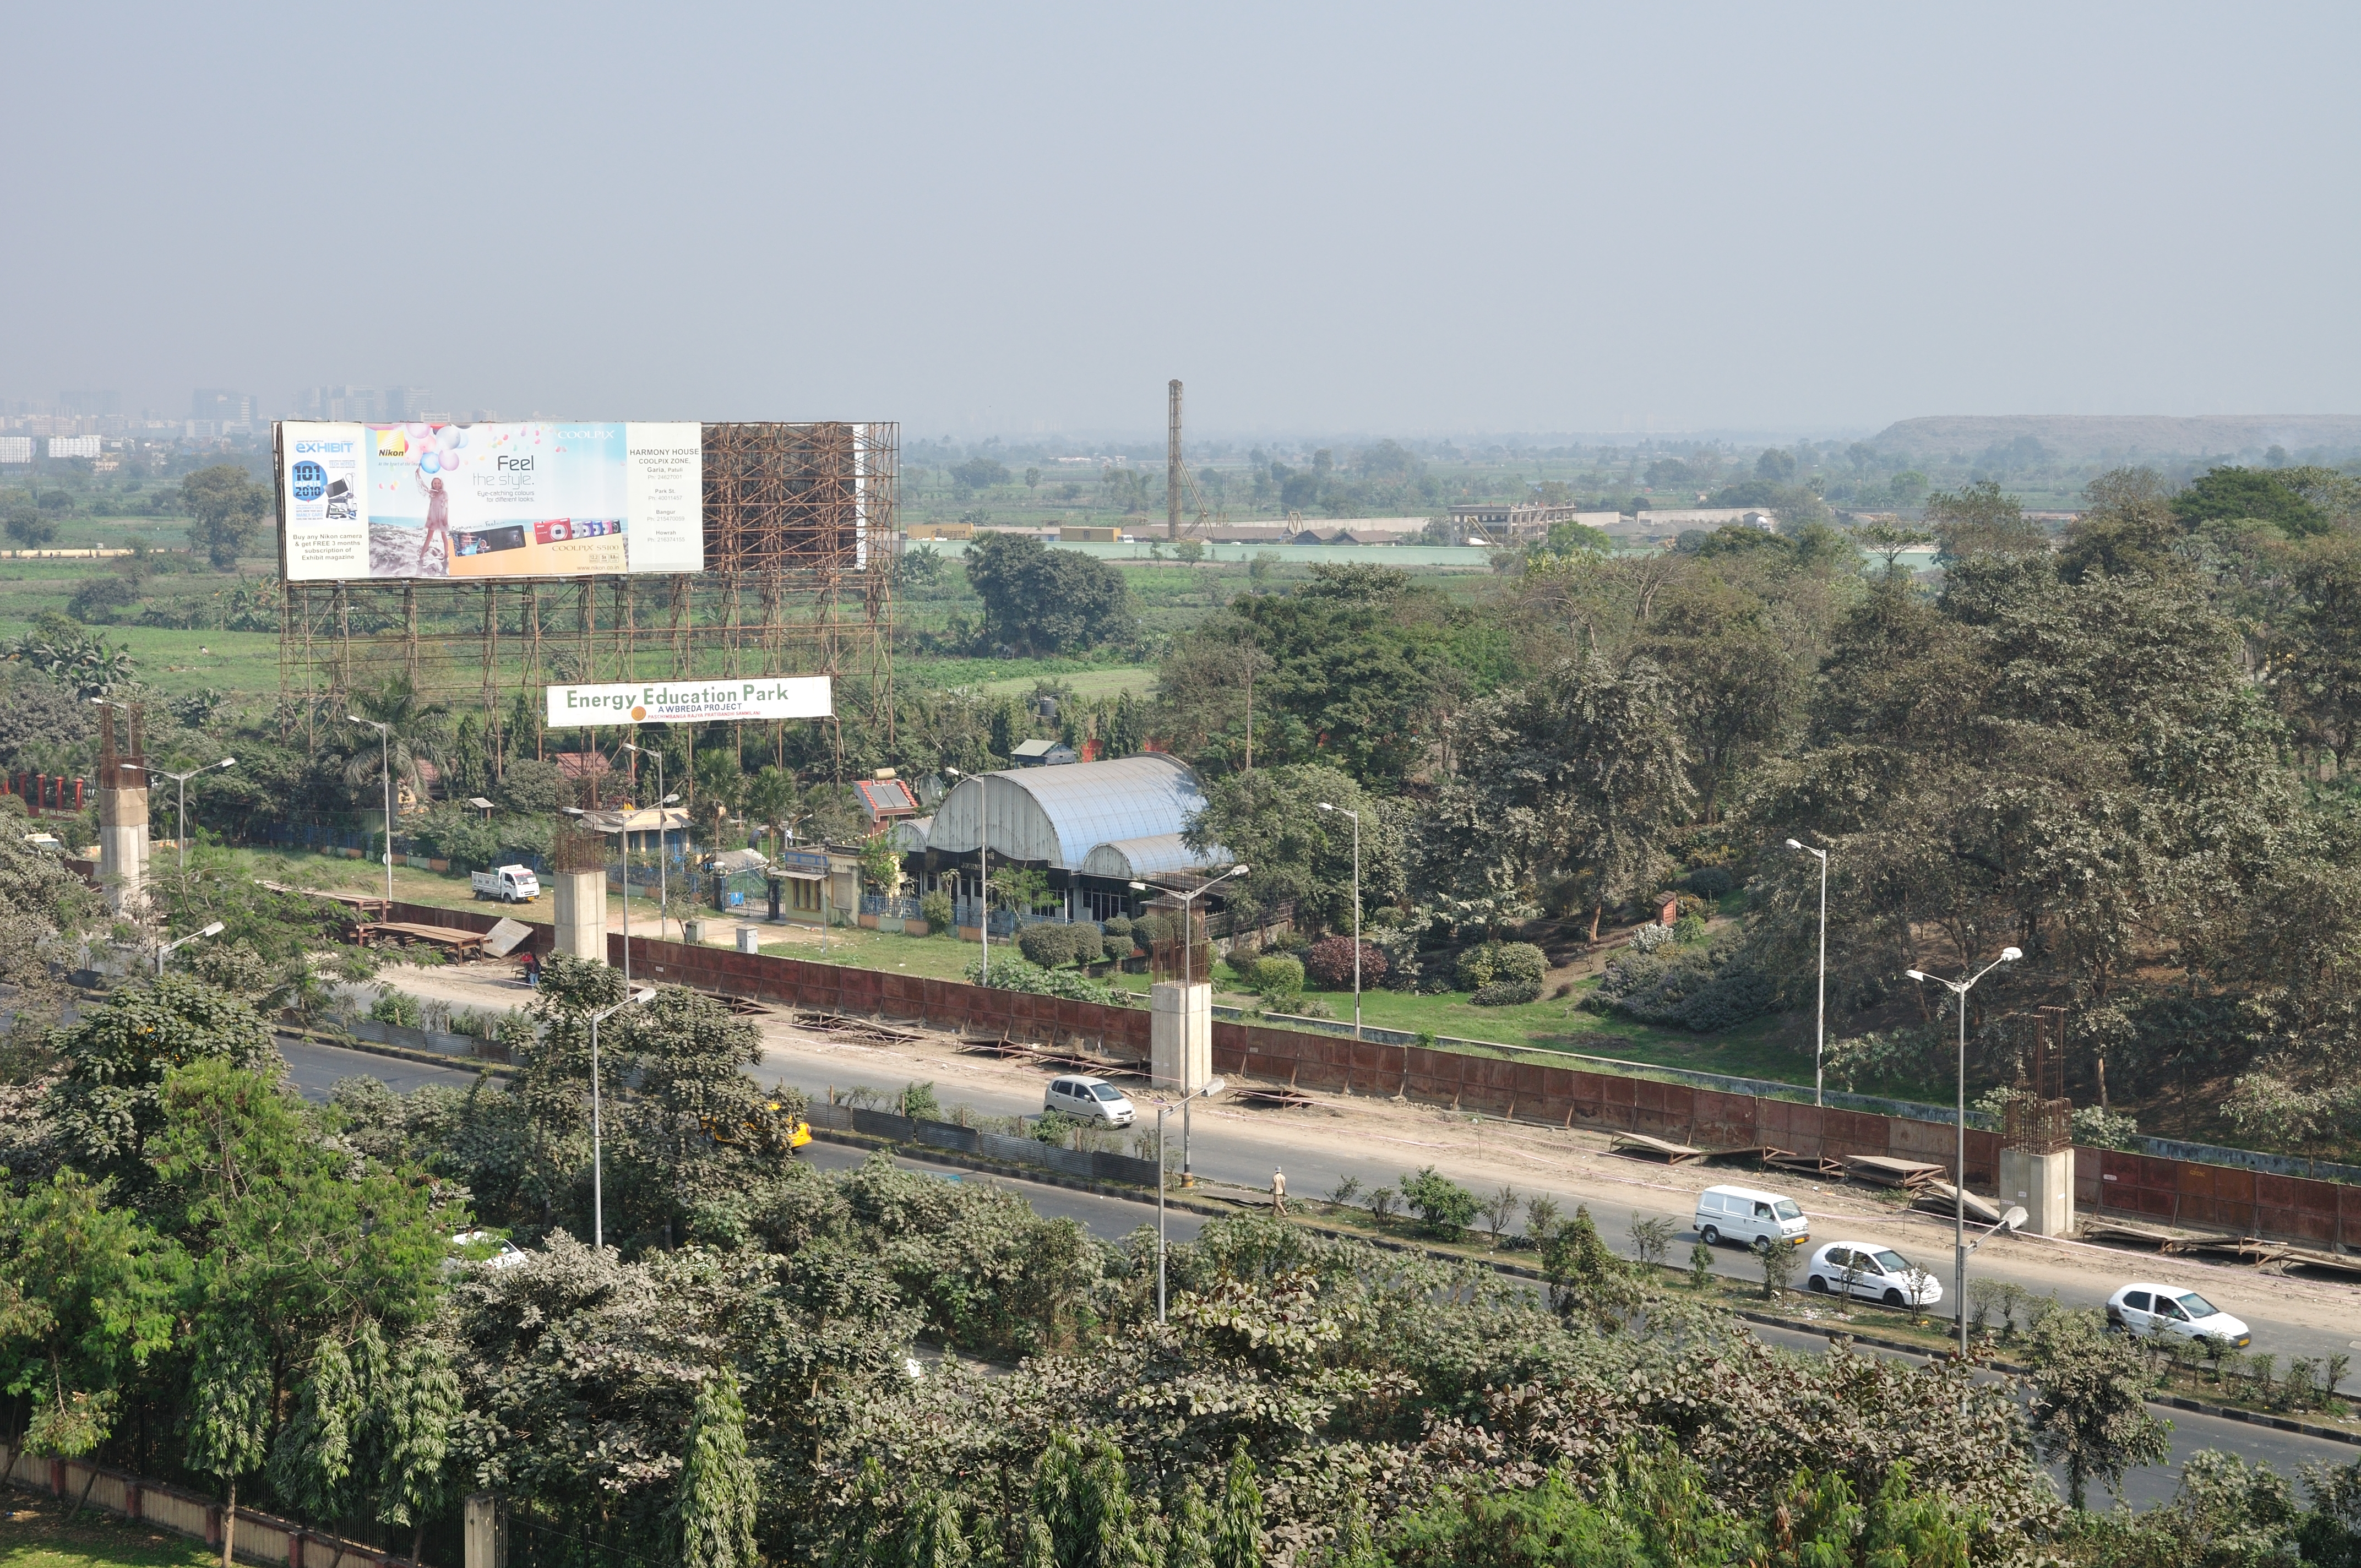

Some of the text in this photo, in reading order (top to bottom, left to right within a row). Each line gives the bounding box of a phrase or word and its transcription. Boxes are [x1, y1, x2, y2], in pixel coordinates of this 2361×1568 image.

[558, 430, 615, 440] COOLPIX
[498, 455, 534, 471] Feel
[295, 466, 320, 481] 101
[474, 472, 534, 489] the style.
[296, 487, 321, 496] 2010
[567, 683, 789, 710] Energy Education Park
[704, 703, 742, 711] PROJECT
